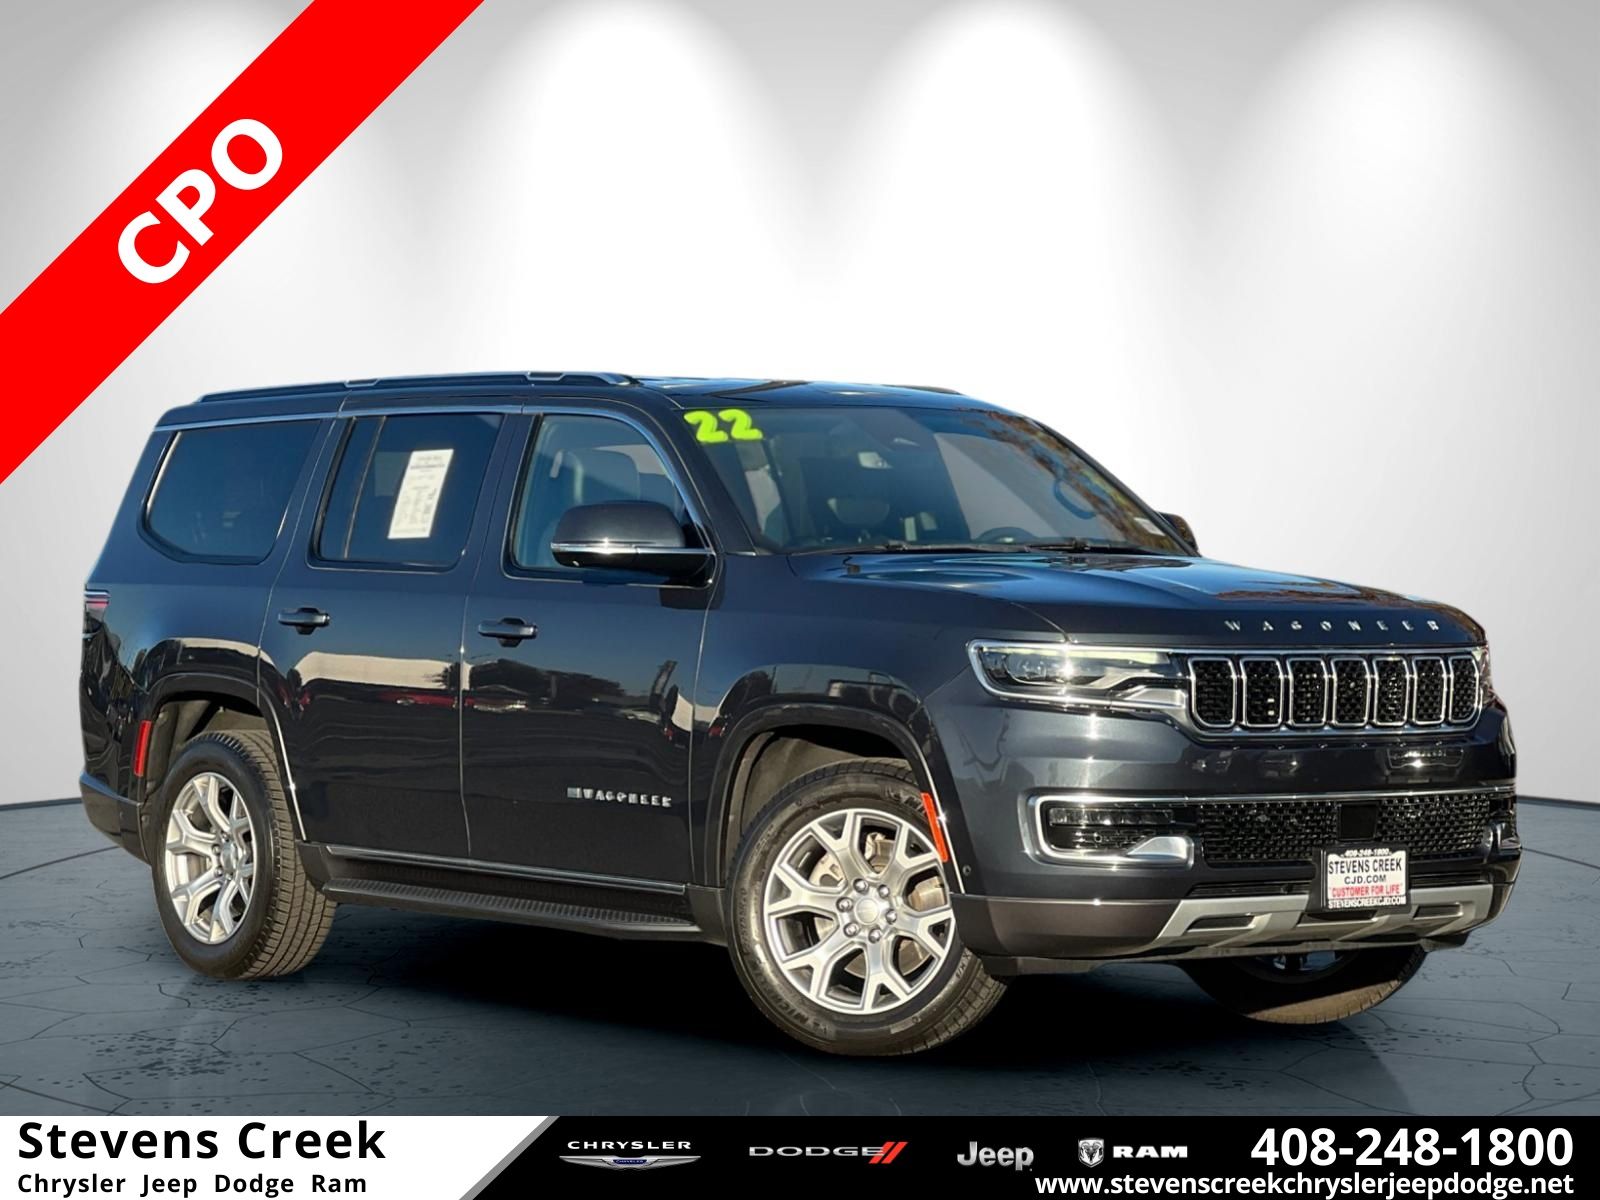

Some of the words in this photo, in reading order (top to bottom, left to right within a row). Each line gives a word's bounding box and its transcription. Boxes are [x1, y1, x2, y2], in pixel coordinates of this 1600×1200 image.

[683, 408, 763, 443] 22
[1223, 620, 1440, 632] WAGONEER
[1328, 860, 1370, 875] STEVENS
[1372, 858, 1402, 873] CREEK
[1344, 874, 1387, 885] CJD.COM
[1371, 885, 1384, 896] FOR
